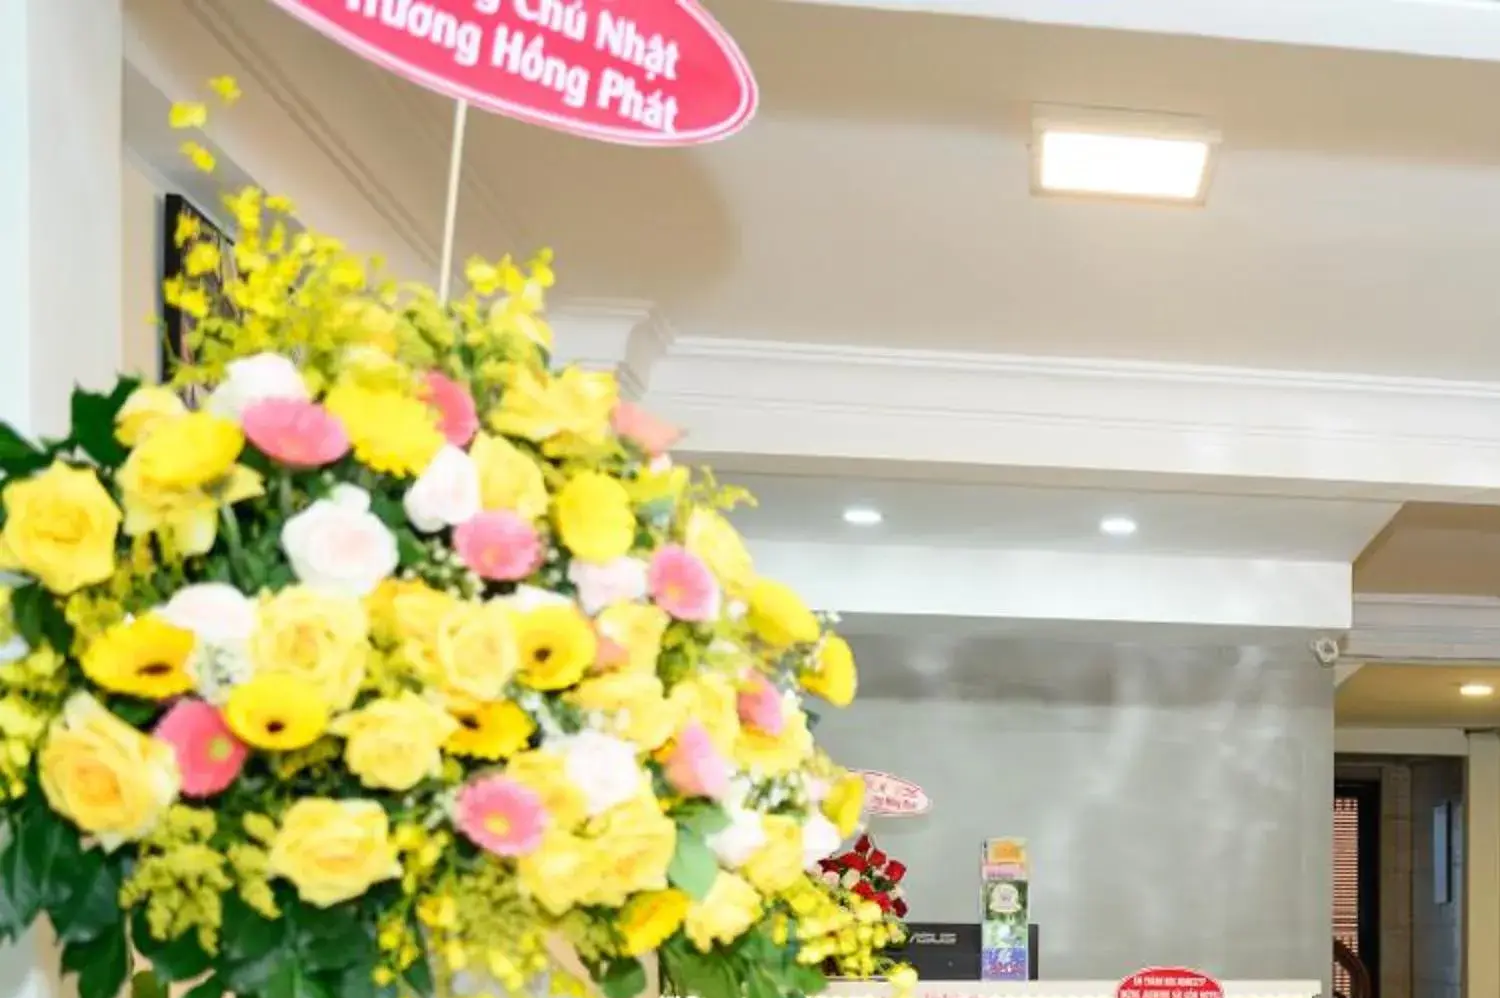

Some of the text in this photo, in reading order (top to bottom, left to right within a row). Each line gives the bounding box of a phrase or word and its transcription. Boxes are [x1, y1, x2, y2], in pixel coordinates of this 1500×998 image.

[345, 0, 483, 67] rương
[597, 66, 680, 134] Phát
[594, 9, 680, 80] Nhật
[909, 932, 957, 945] ASUS
